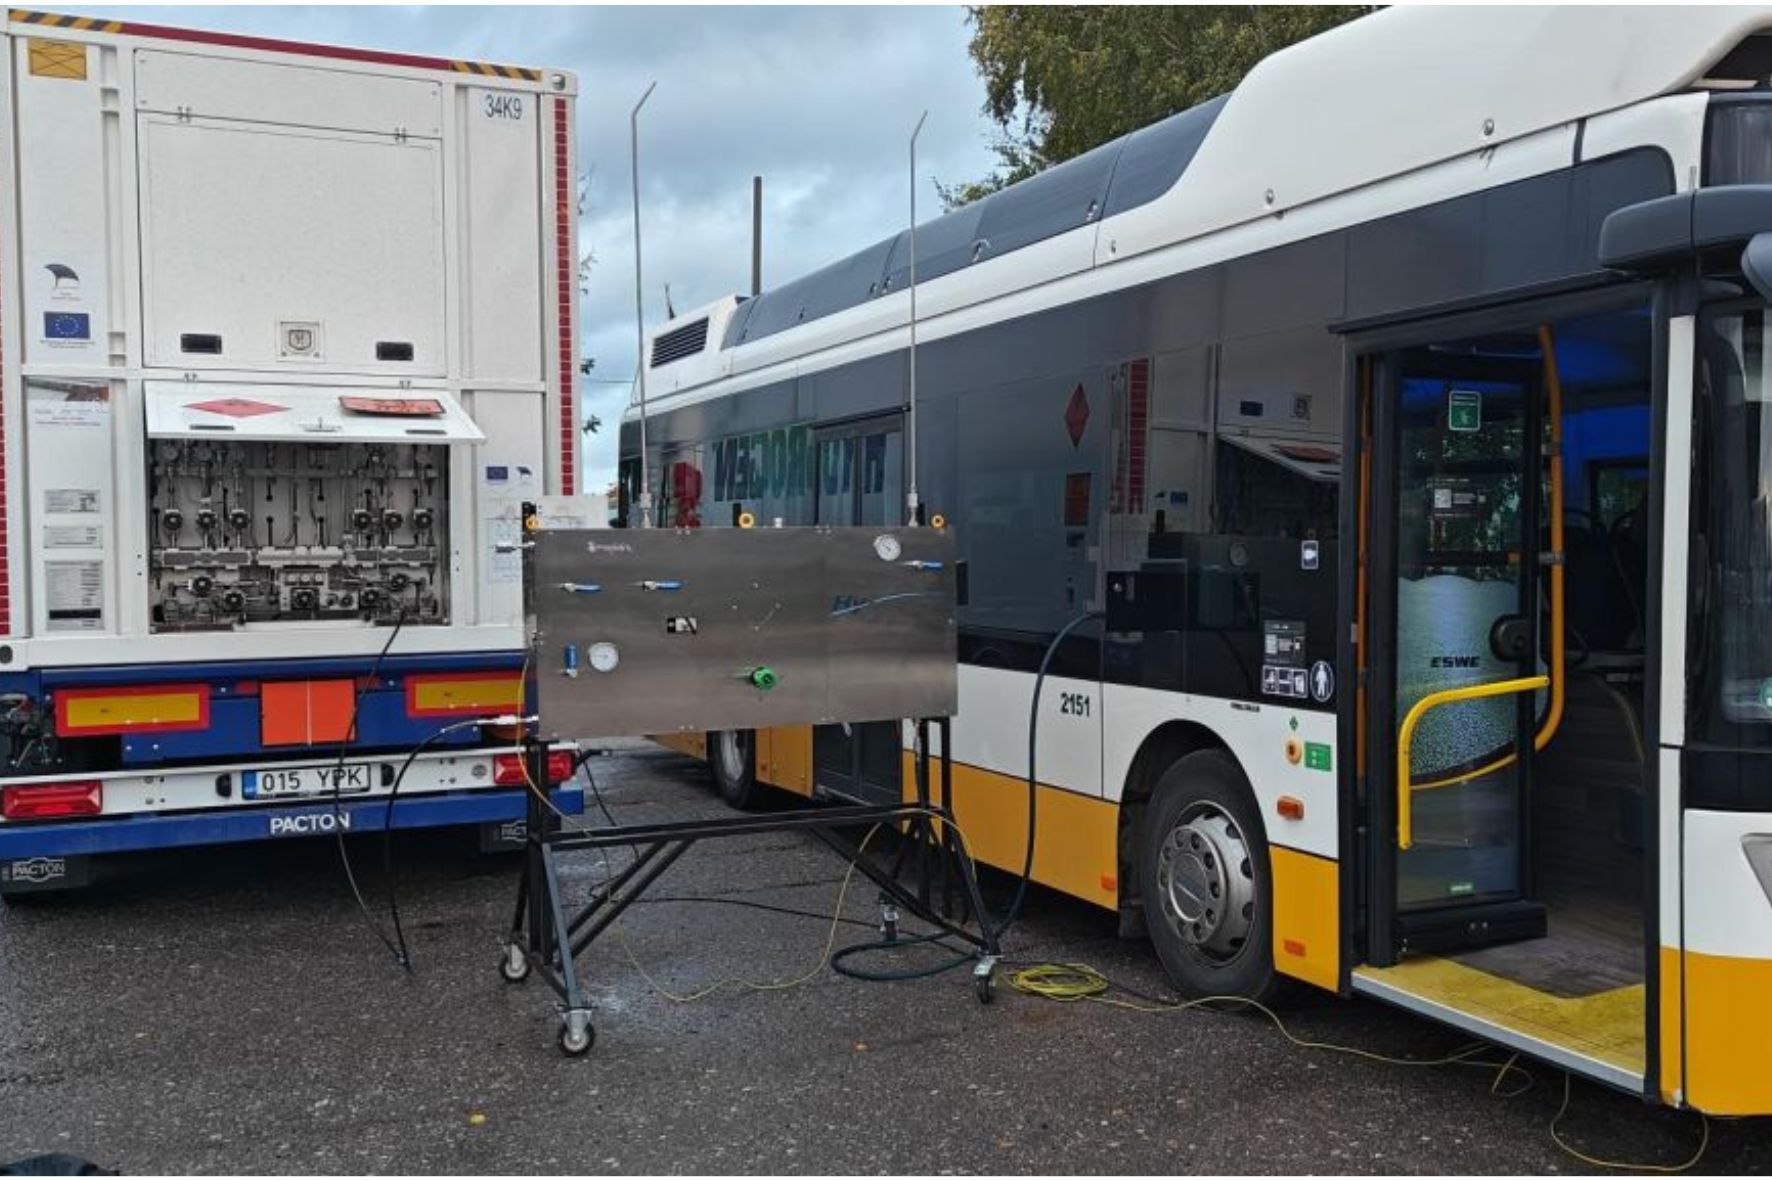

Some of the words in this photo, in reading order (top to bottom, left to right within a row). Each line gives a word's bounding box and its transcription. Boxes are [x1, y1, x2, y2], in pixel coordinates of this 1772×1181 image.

[485, 94, 523, 120] 34K9
[1430, 656, 1481, 668] ESWE
[1060, 692, 1090, 718] 2151
[262, 772, 301, 792] 015
[316, 767, 362, 788] YPK
[270, 813, 351, 835] PACTON
[12, 863, 66, 877] PACTON
